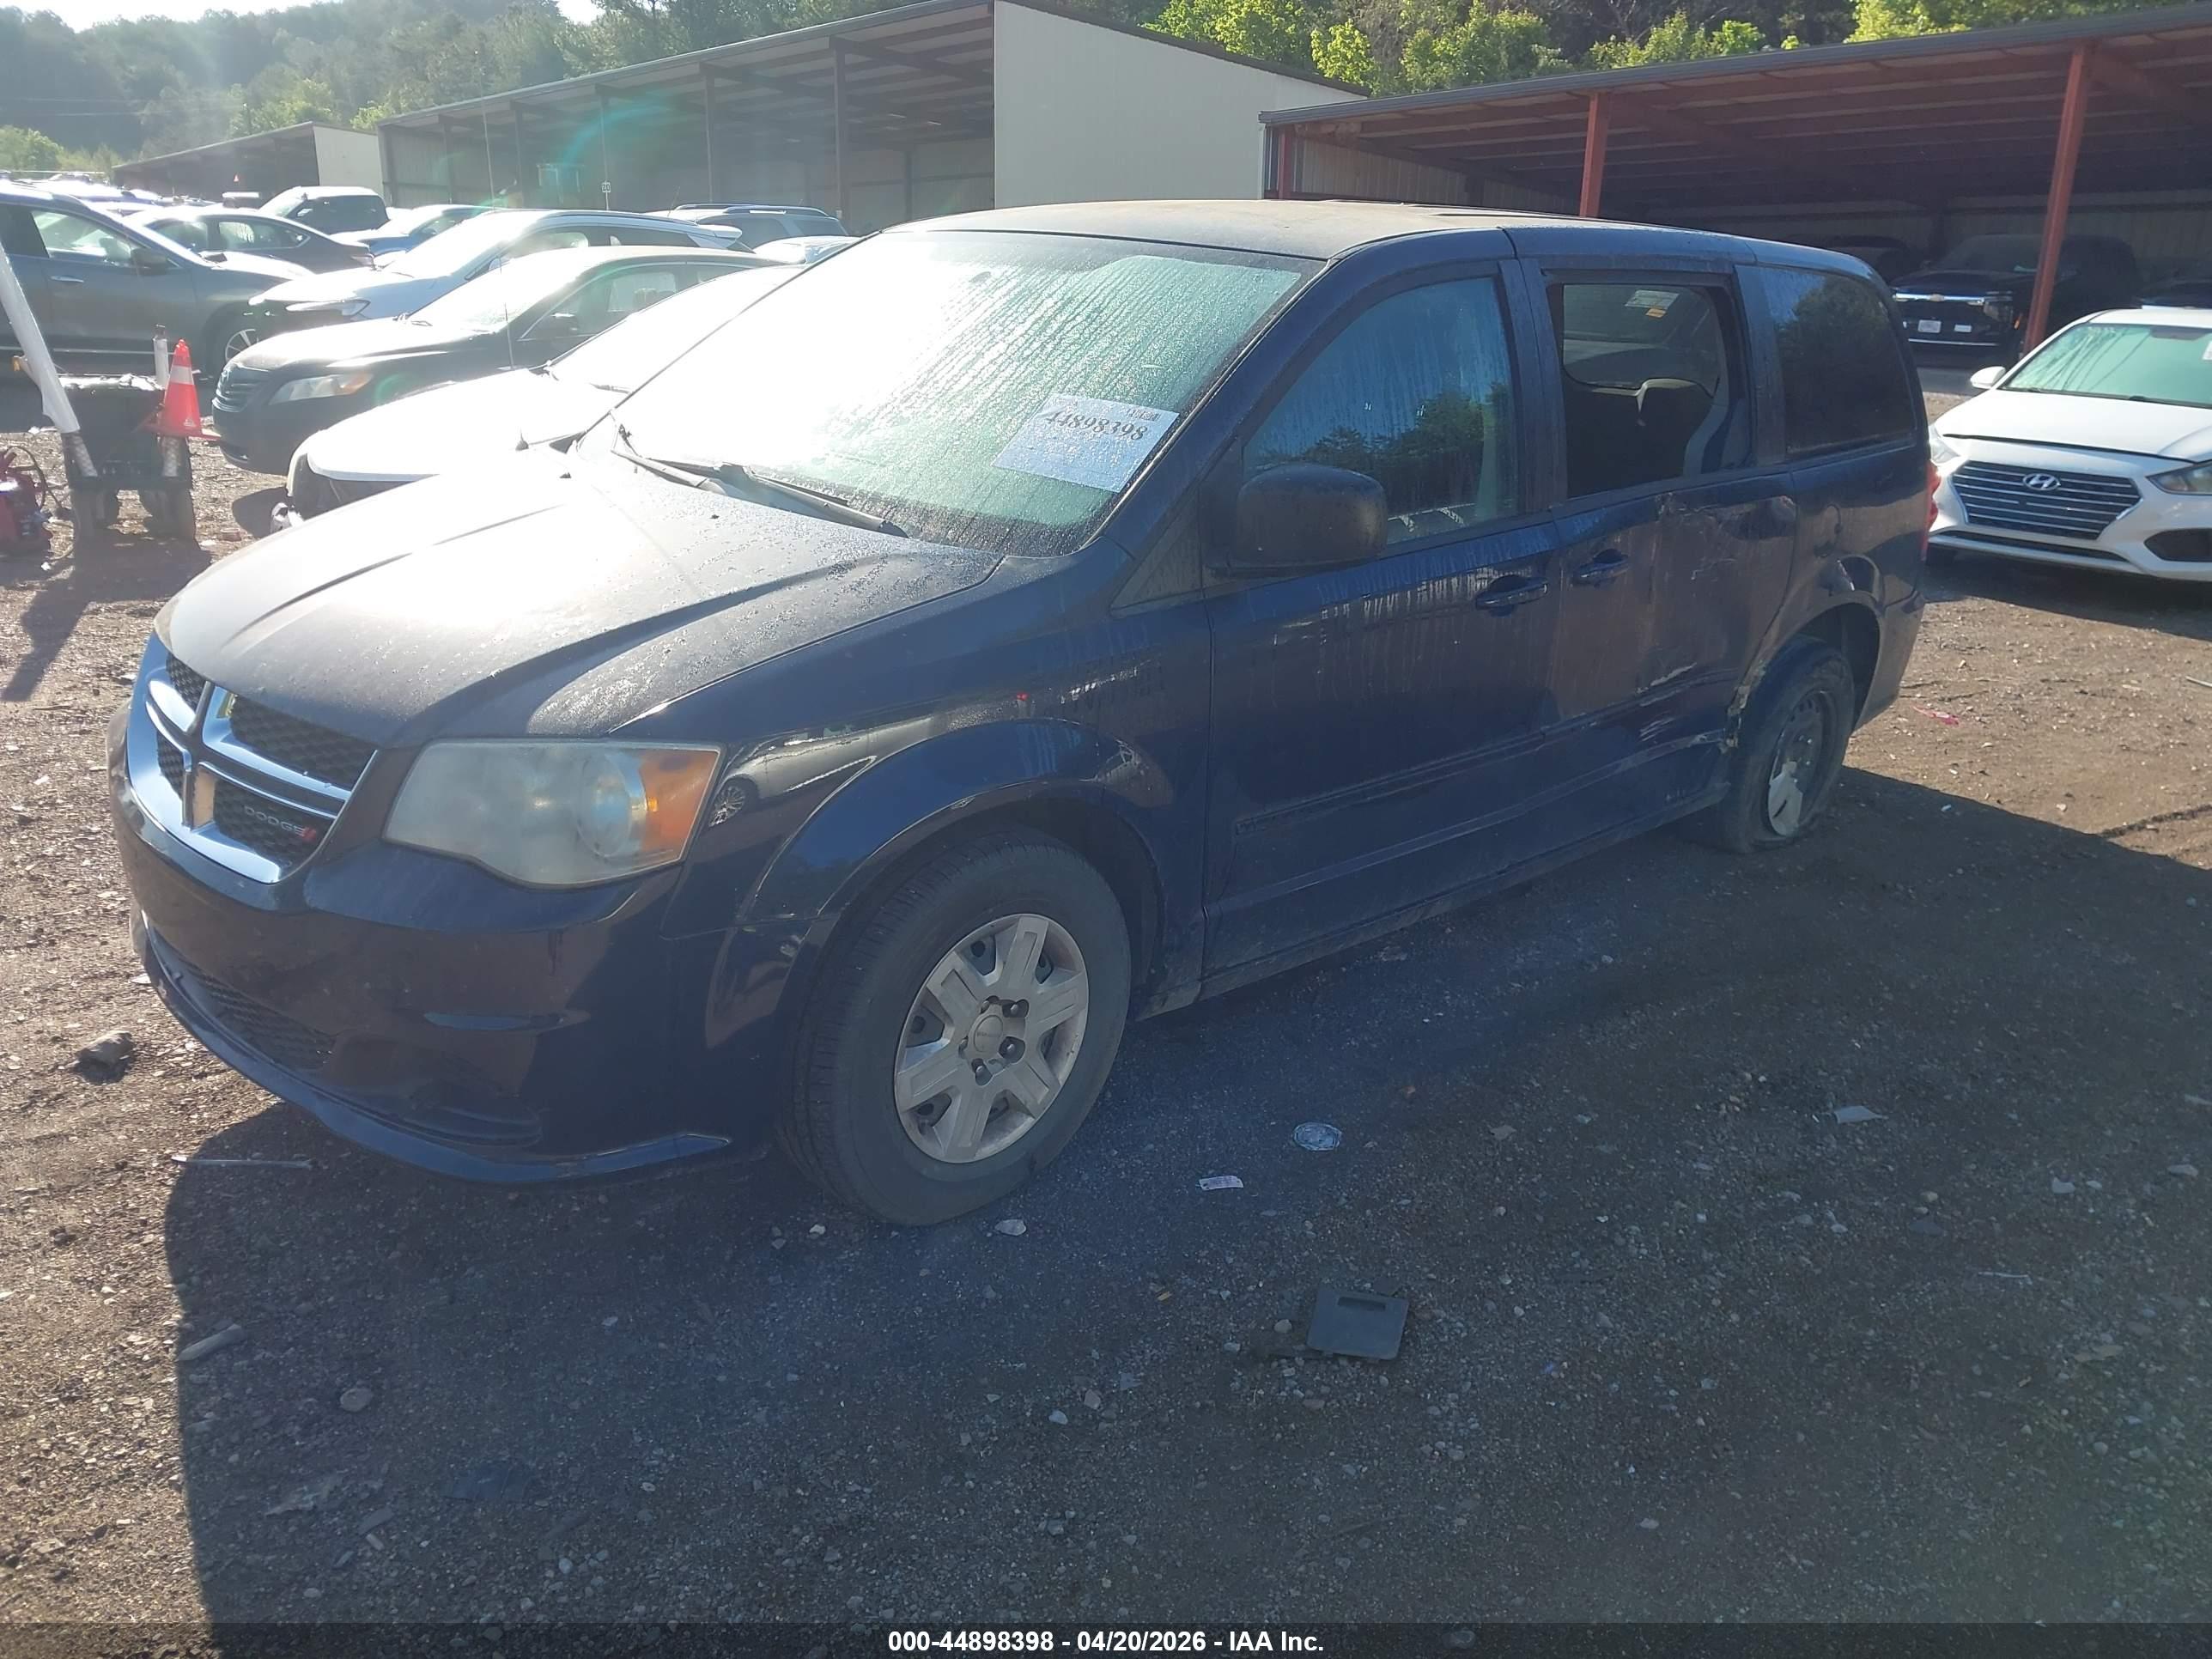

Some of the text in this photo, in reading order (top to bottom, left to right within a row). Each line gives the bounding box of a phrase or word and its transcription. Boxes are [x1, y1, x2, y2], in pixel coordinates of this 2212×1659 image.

[602, 183, 611, 192] 20
[1046, 410, 1147, 440] 44898398
[244, 806, 306, 836] DODGE
